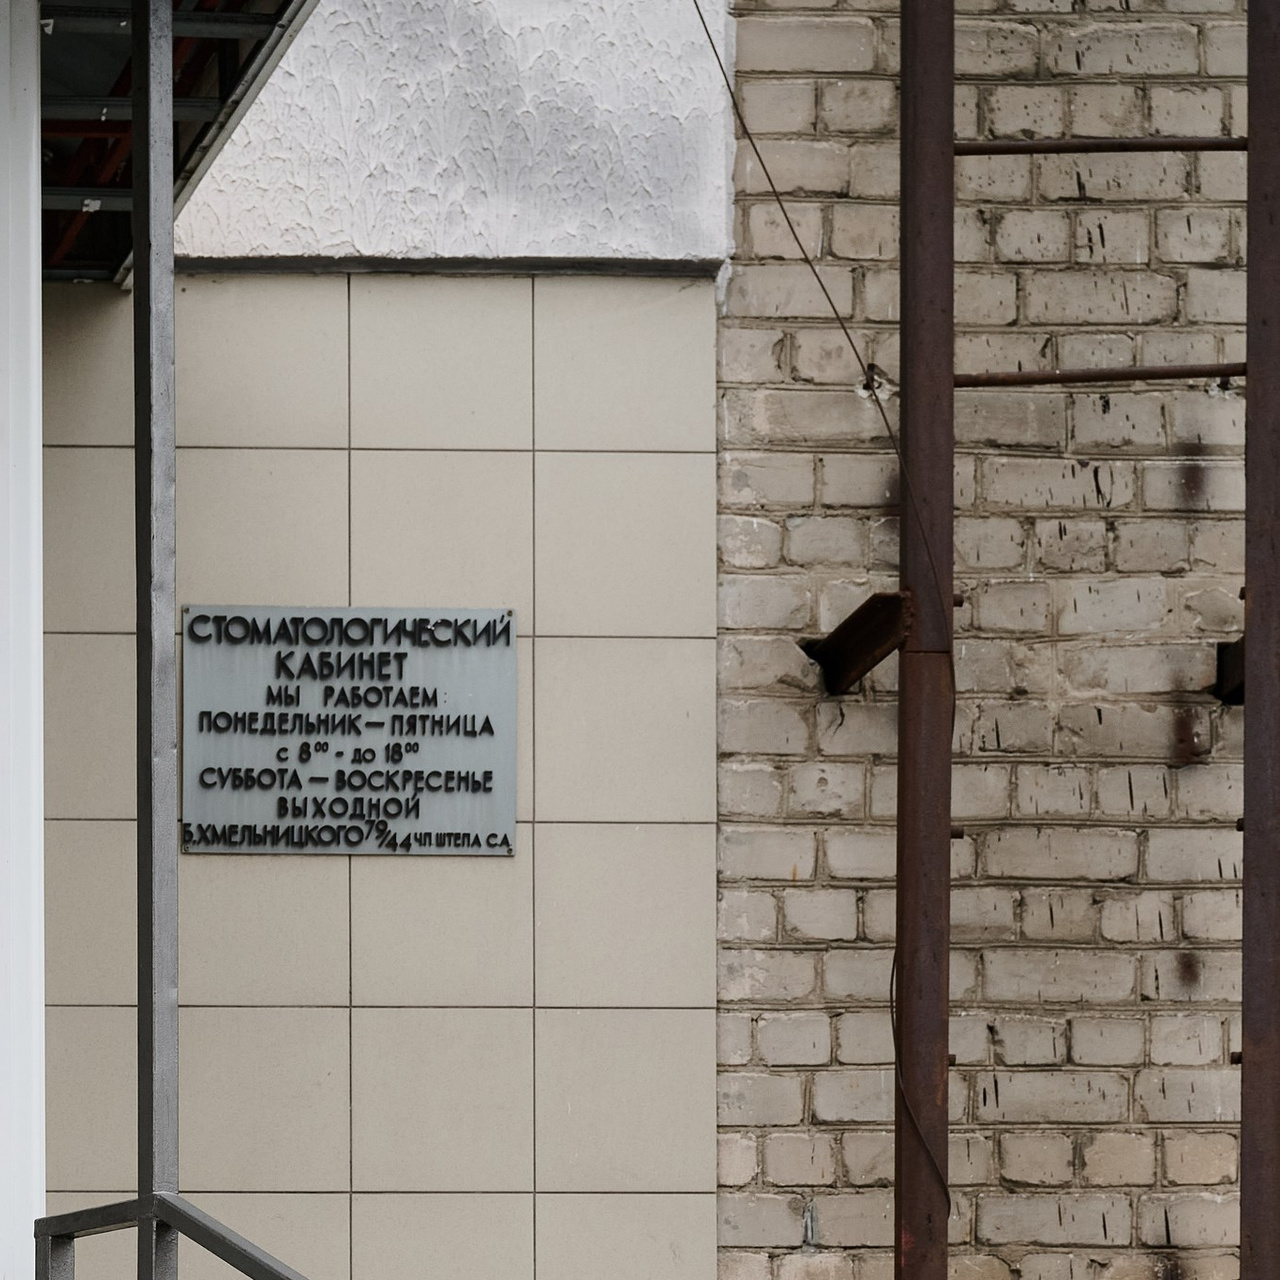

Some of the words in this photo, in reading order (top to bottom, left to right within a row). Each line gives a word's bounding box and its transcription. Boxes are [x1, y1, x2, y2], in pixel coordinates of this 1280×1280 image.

[188, 614, 511, 648] СТОМАТОЛОГИЧЕСКИЙ
[275, 650, 408, 681] КАБИНЕТ
[266, 685, 300, 707] МЫ
[198, 710, 362, 736] ПОНЕДЕЛЬНИК
[391, 714, 495, 738] ПЯТНИЦА
[199, 767, 303, 791] СУББОТА
[335, 769, 493, 793] ВОСКРЕСЕНЬЕ
[277, 792, 420, 820] ВЫХОДНОЙ
